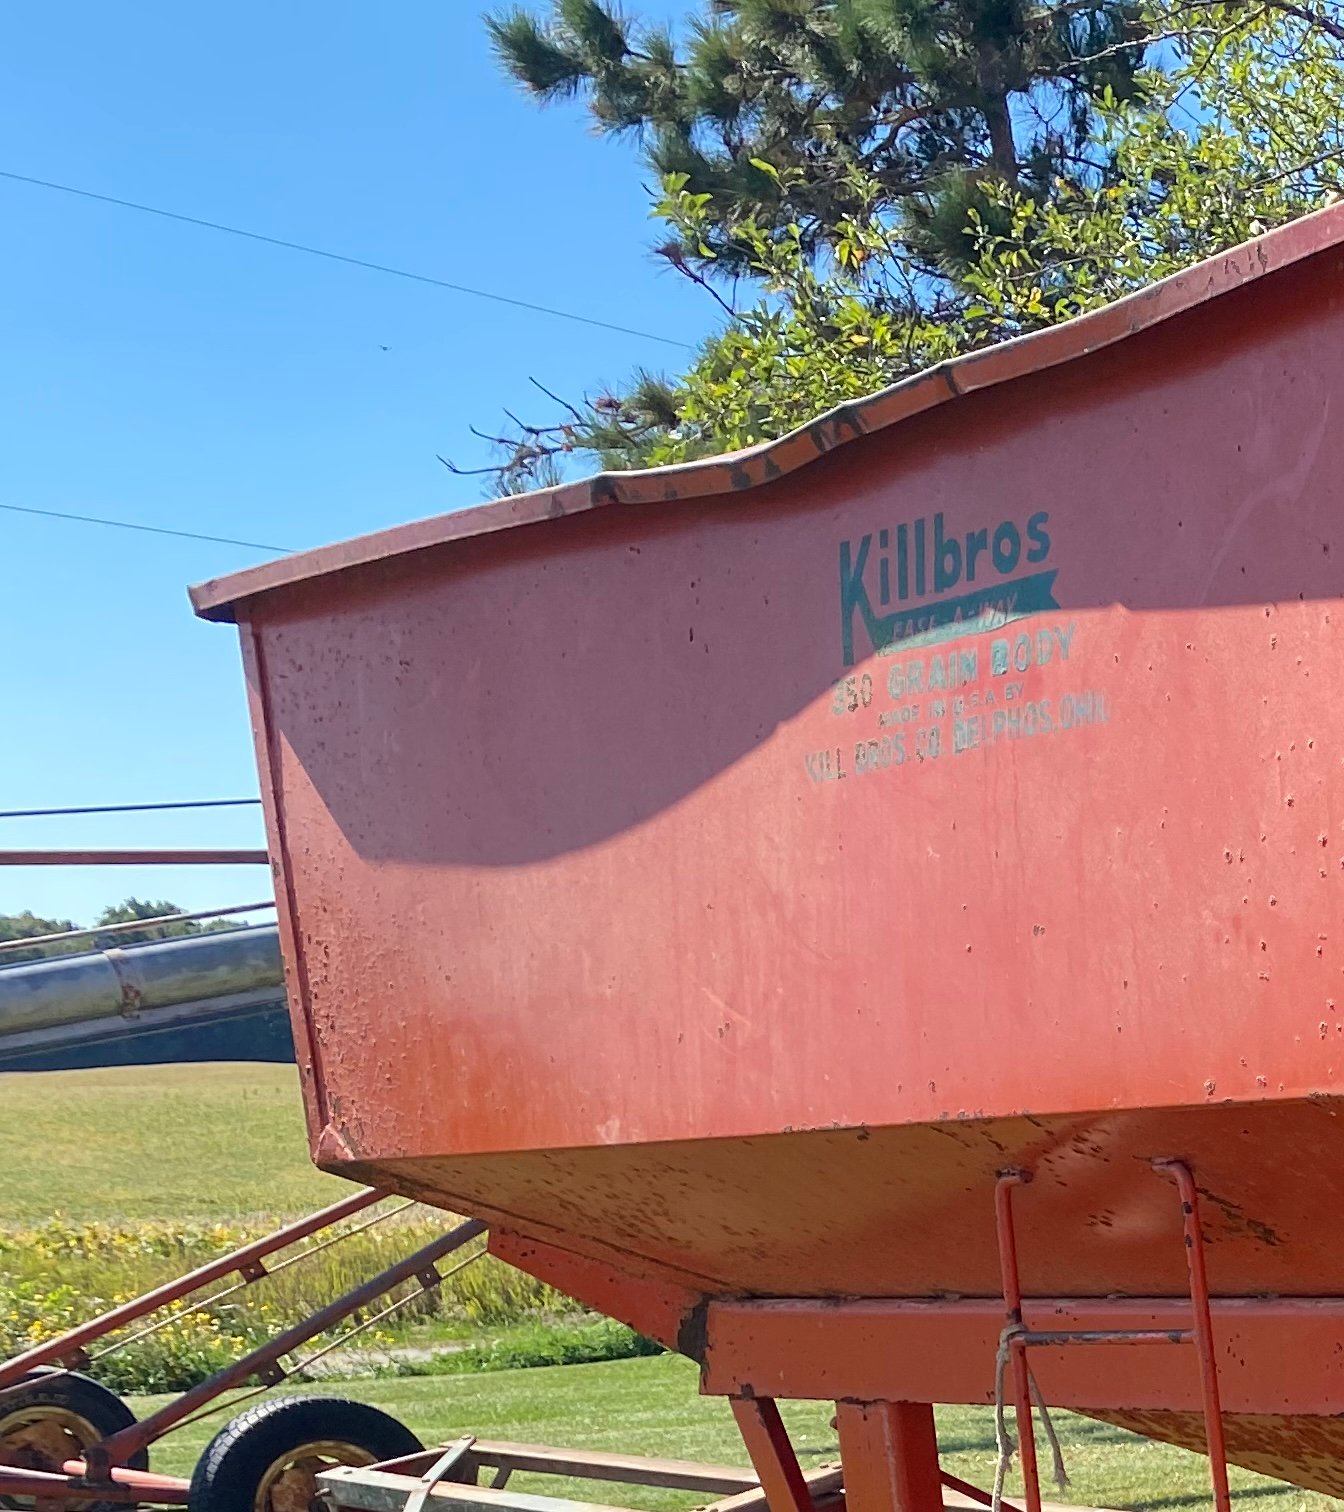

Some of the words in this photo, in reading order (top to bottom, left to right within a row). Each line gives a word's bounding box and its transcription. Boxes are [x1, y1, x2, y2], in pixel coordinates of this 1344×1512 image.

[838, 511, 1051, 667] Killbros
[886, 648, 978, 701] GRAIN
[991, 620, 1078, 678] BODY
[1004, 682, 1025, 701] BY
